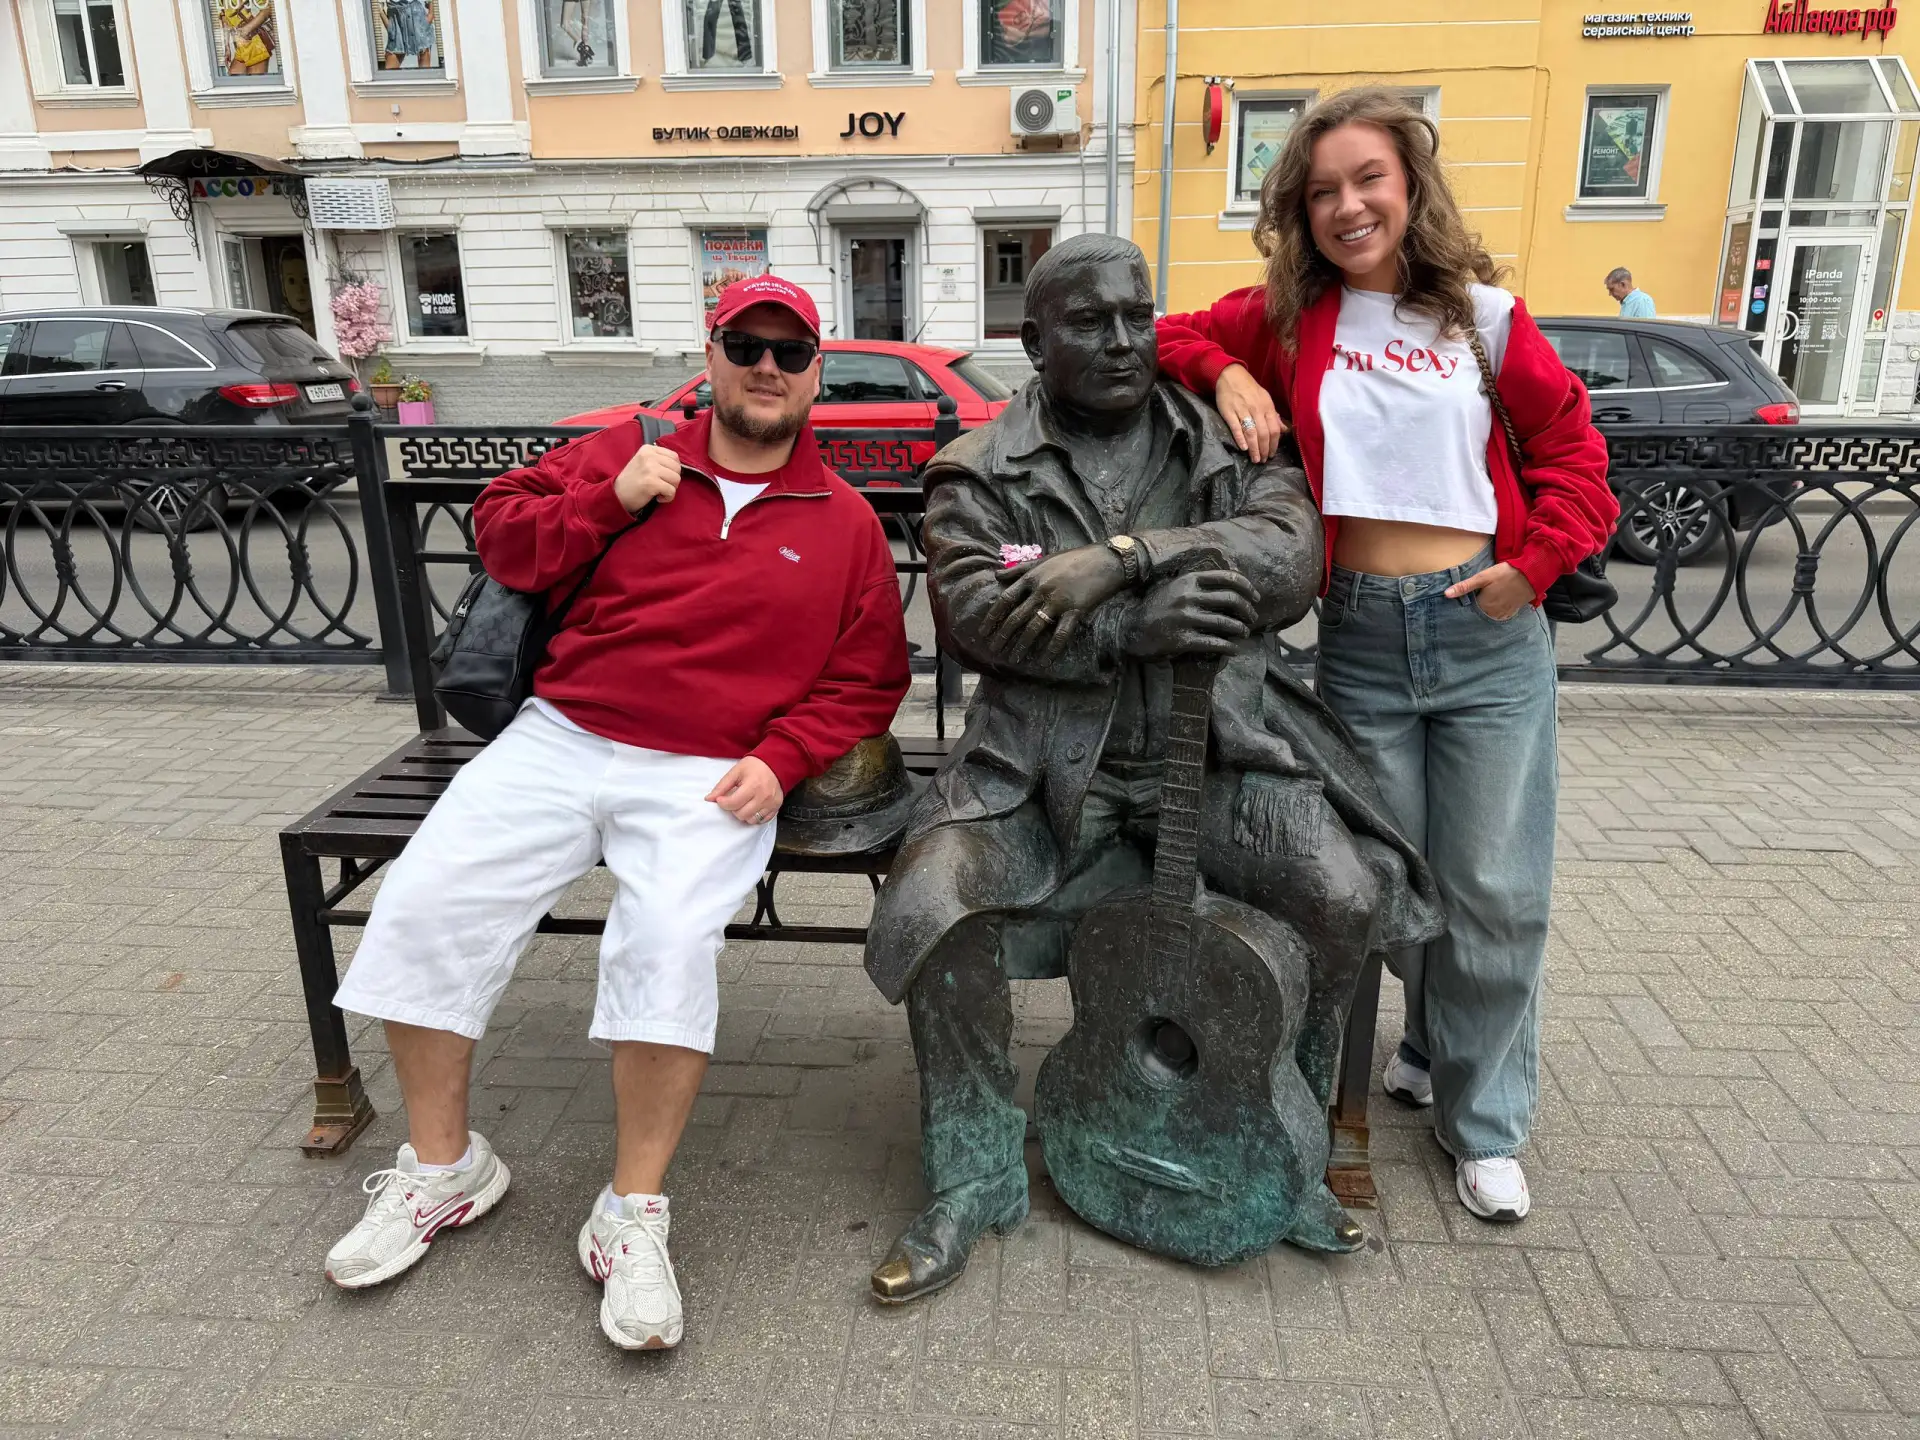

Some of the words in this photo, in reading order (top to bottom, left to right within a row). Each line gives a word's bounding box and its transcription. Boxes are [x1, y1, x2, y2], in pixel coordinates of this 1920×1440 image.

[1583, 13, 1638, 24] магазин
[1640, 12, 1693, 23] техники
[1583, 23, 1655, 38] сервисный
[1656, 24, 1696, 36] центр
[840, 111, 906, 138] JOY
[652, 126, 711, 141] БУТИК
[716, 125, 799, 139] ОДЕЖДЫ
[705, 240, 764, 251] ПОДАРКИ
[726, 252, 758, 262] Твери
[1805, 268, 1843, 279] iPanda
[743, 281, 771, 292] STATEN
[771, 282, 798, 299] ISLAND
[432, 293, 457, 305] КОФЕ
[1381, 339, 1459, 379] Sexy
